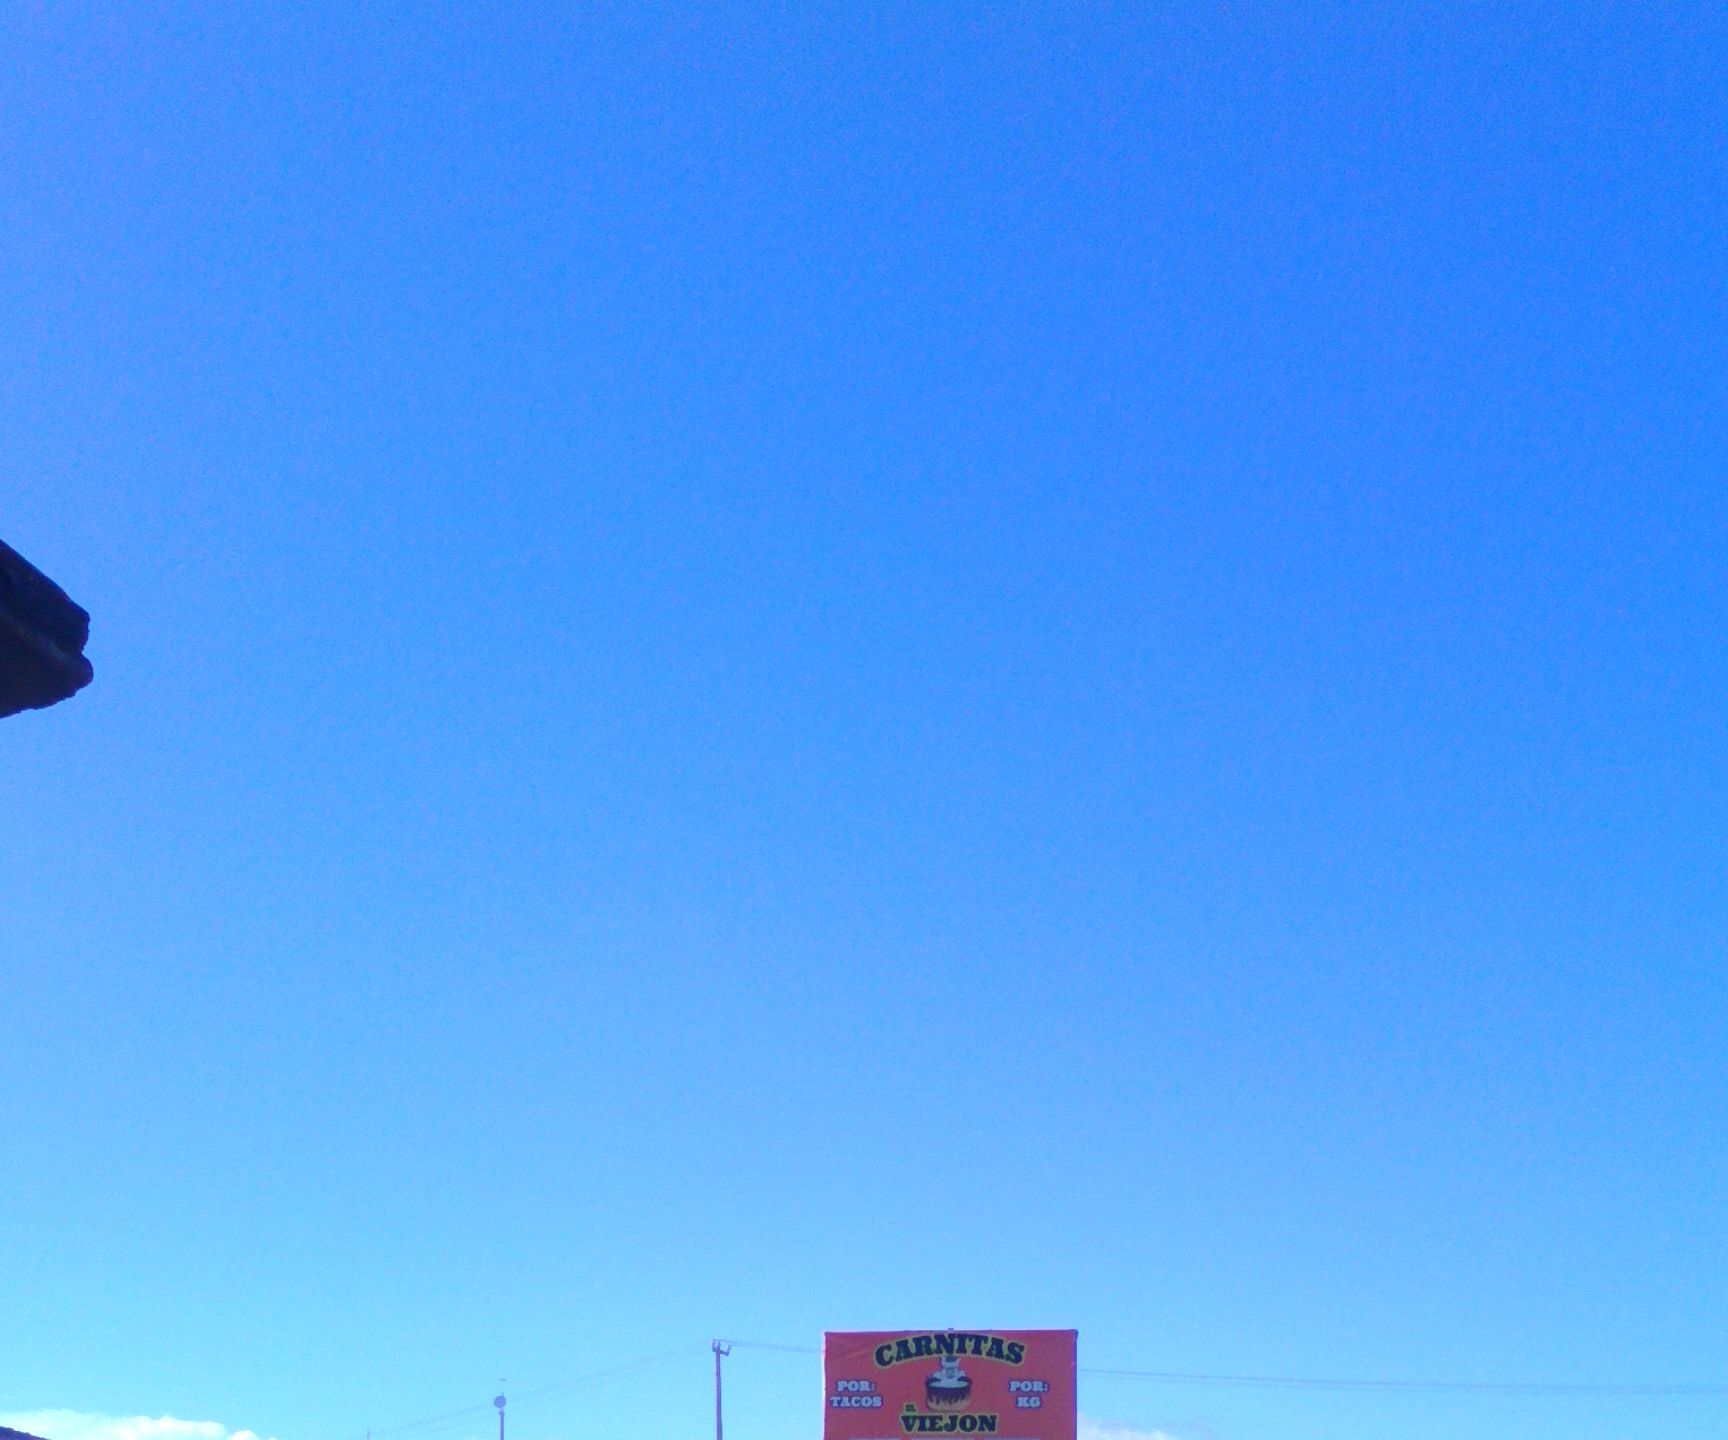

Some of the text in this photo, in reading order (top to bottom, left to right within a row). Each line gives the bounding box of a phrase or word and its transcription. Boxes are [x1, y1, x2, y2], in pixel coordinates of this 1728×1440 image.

[875, 1333, 1025, 1366] CARNITAS
[836, 1380, 876, 1391] POR:
[1009, 1380, 1049, 1391] POR:
[829, 1396, 882, 1407] TACOS
[1017, 1396, 1041, 1407] KG
[901, 1414, 997, 1432] VIEJON
